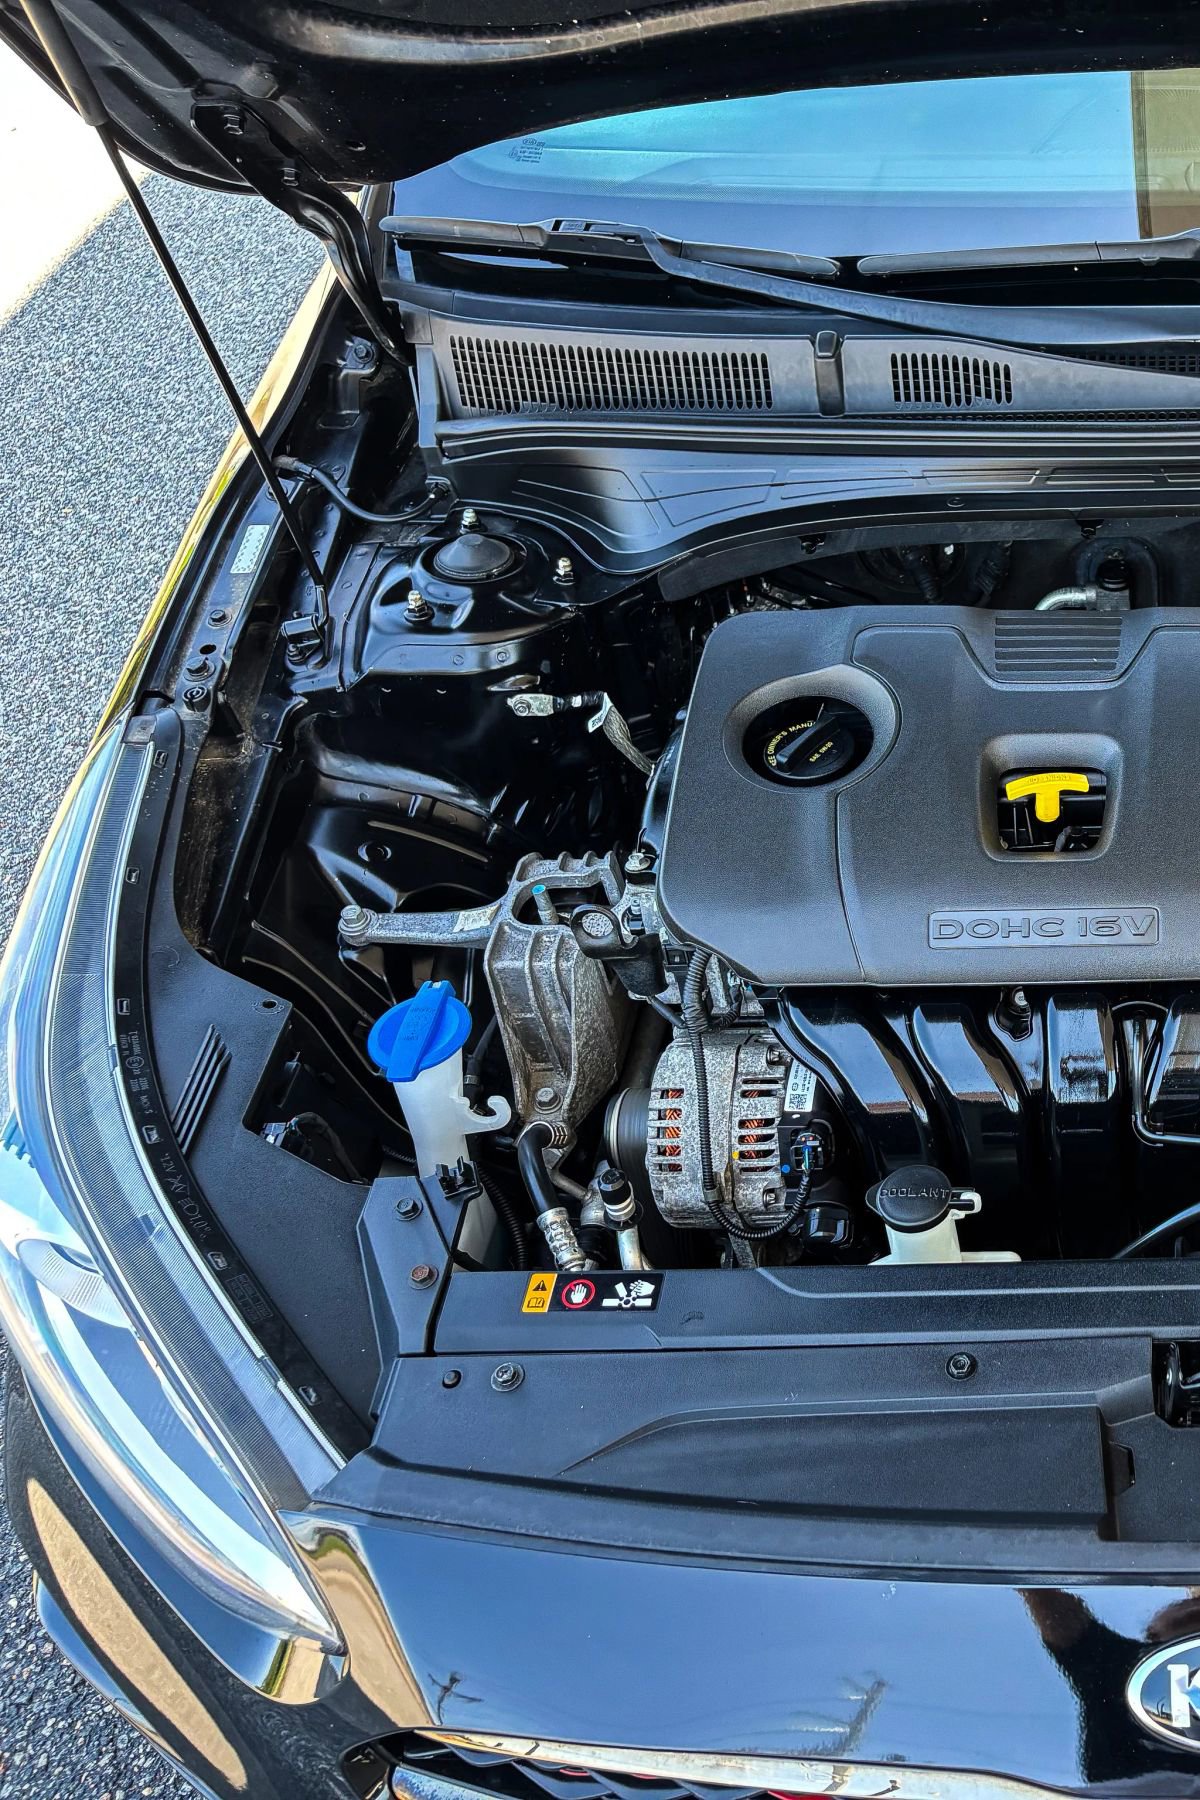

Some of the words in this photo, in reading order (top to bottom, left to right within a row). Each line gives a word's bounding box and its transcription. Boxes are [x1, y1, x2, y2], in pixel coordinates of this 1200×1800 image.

[932, 917, 1065, 940] DOHC
[1077, 915, 1155, 937] 16V
[880, 1186, 950, 1199] COOLANT
